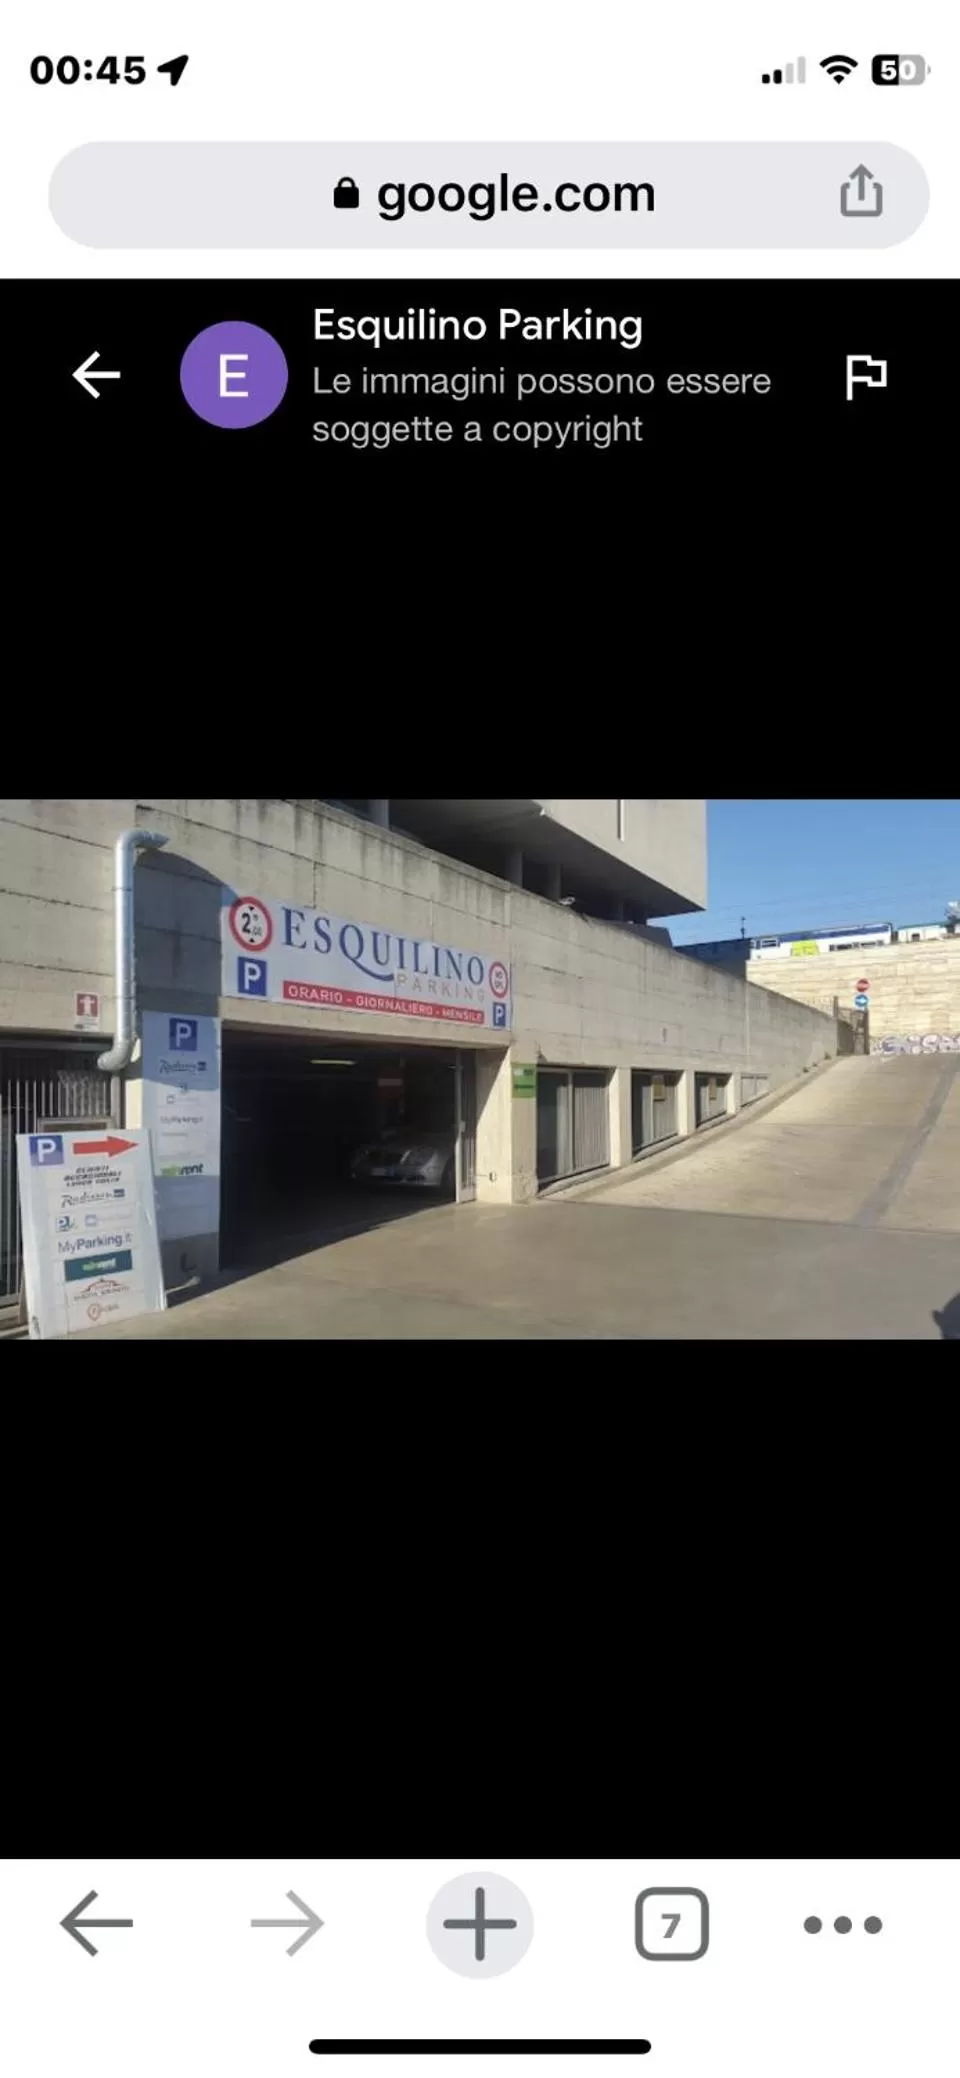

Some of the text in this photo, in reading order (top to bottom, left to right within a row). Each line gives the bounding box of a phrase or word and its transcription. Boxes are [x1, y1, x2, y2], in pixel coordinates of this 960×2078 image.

[29, 54, 147, 86] 00:45
[880, 60, 917, 80] 50
[377, 172, 656, 222] google.com
[313, 308, 644, 350] Esquilino Parking
[218, 353, 250, 398] E
[313, 366, 772, 402] Le immagini possono essere
[312, 414, 645, 450] soggette a copyright
[281, 906, 486, 986] ESQUILINO
[243, 961, 262, 991] P
[395, 971, 486, 1003] PARKING
[288, 984, 344, 1005] ORARIO
[355, 995, 434, 1016] GIORNALIERO
[442, 1007, 483, 1023] MENSILE
[175, 1021, 193, 1048] P
[36, 1138, 56, 1163] P
[661, 1913, 682, 1939] 7
